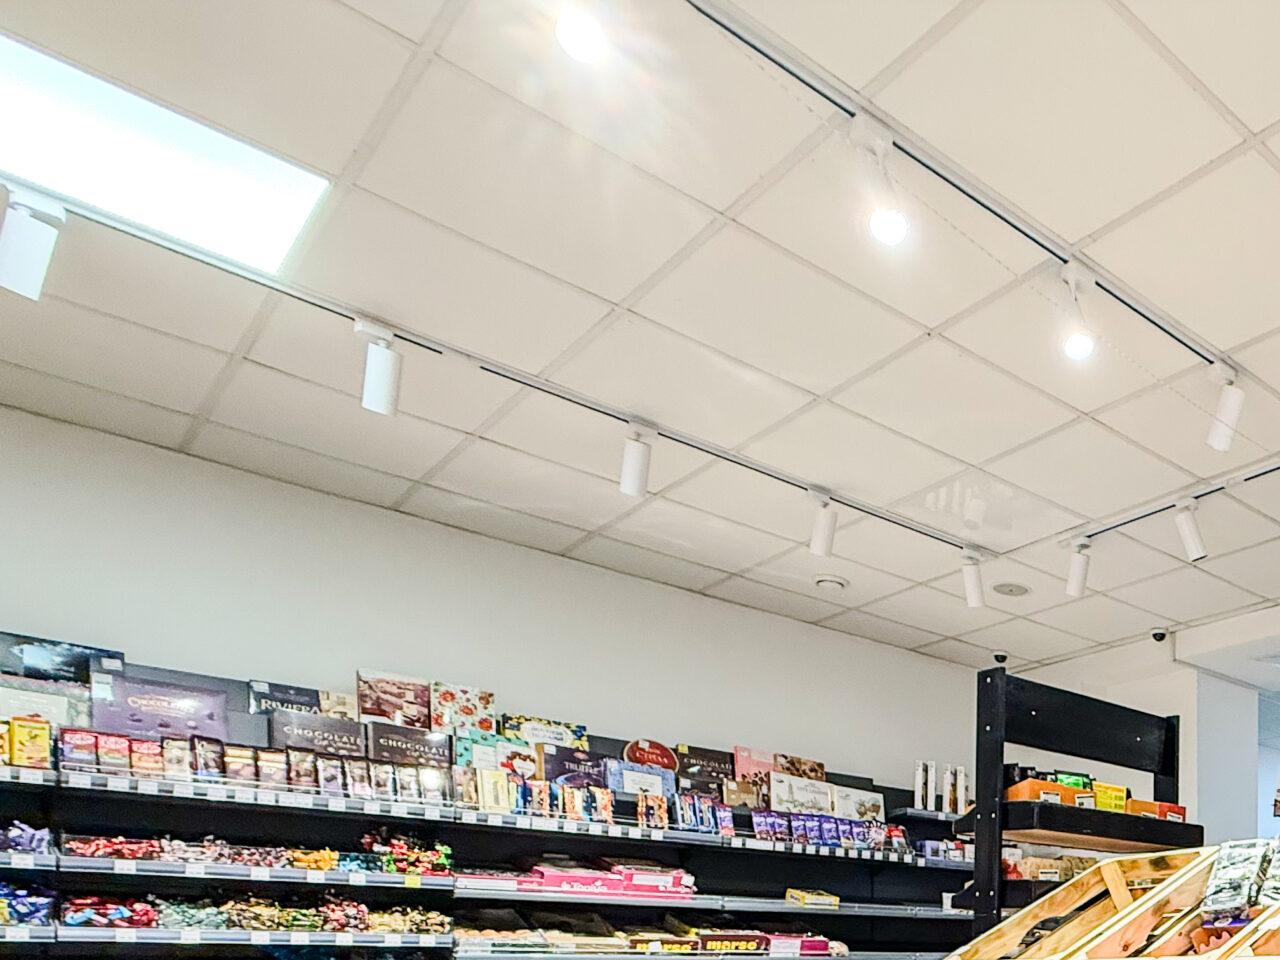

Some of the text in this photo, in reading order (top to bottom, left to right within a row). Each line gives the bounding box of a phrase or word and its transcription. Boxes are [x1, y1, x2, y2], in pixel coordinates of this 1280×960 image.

[283, 725, 362, 745] CHOCOLATE
[379, 738, 449, 757] CHOCOLATE
[636, 942, 692, 951] mrso
